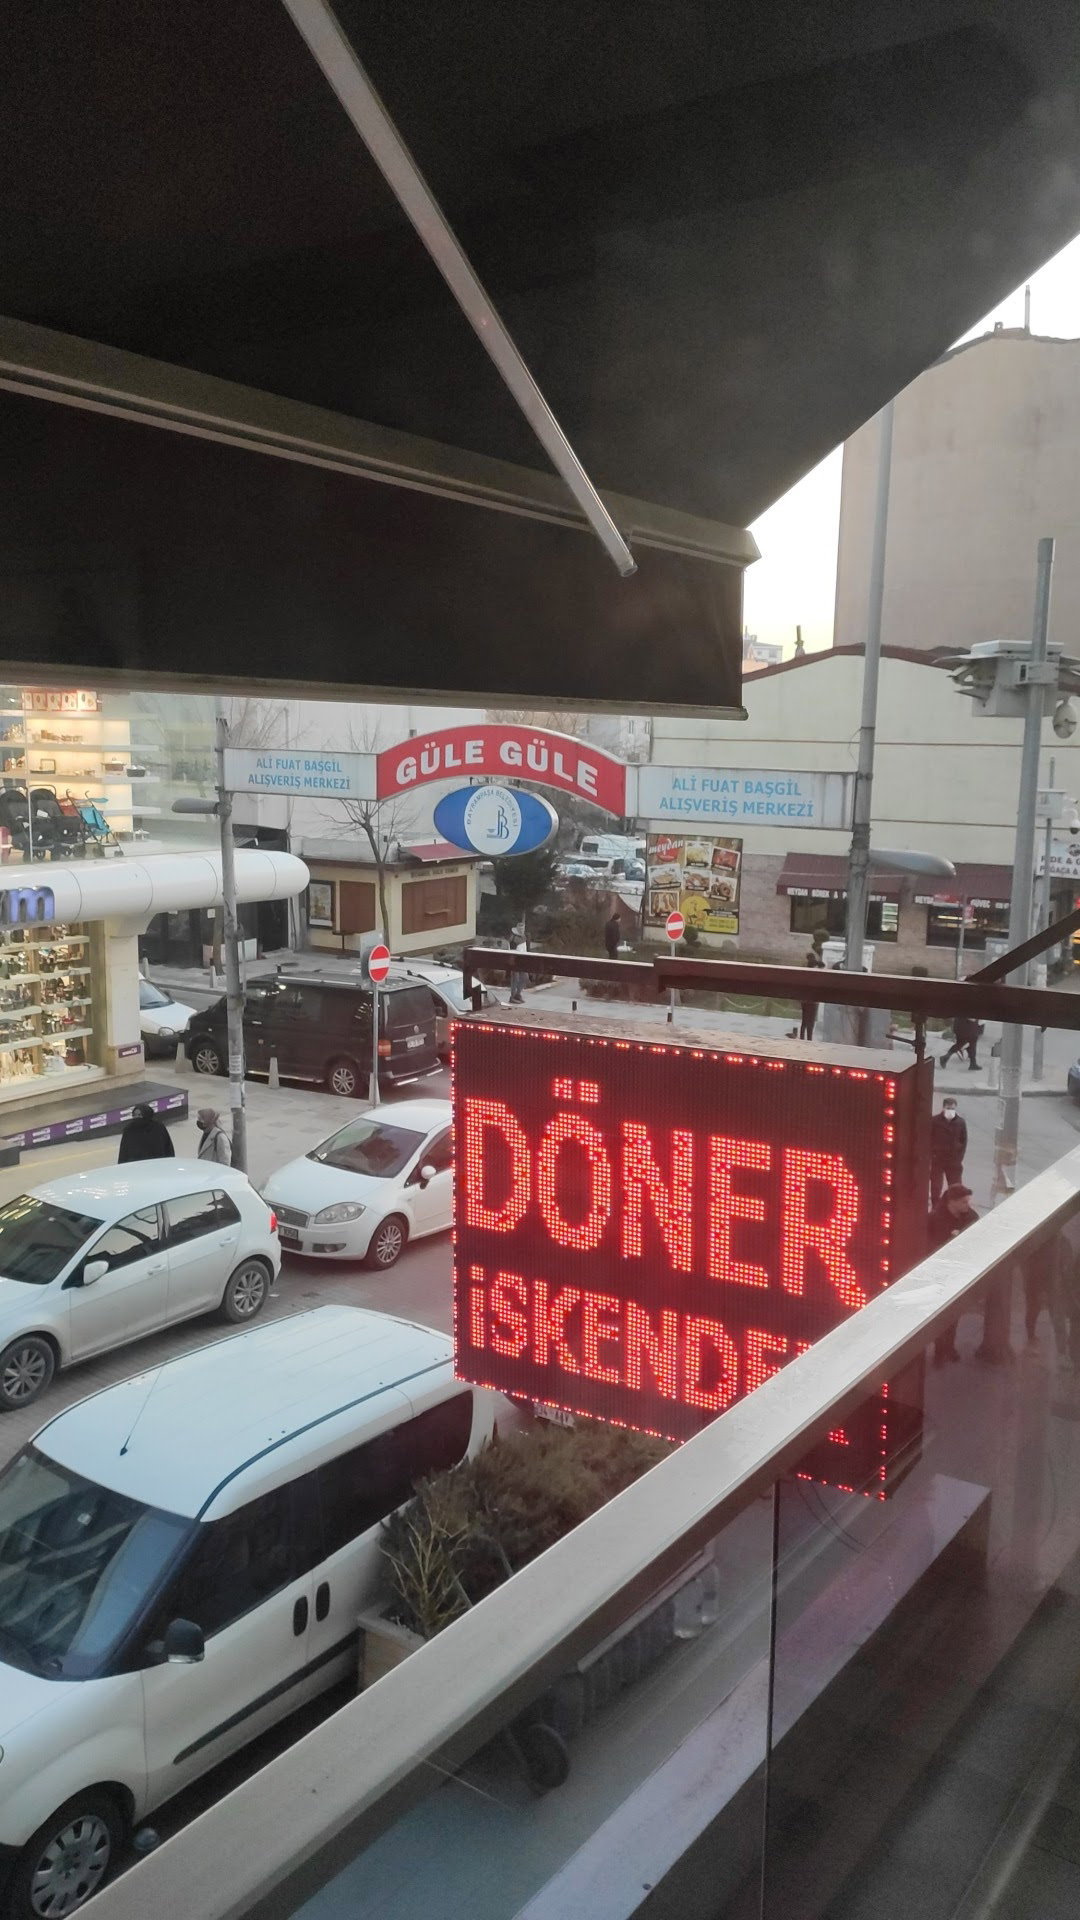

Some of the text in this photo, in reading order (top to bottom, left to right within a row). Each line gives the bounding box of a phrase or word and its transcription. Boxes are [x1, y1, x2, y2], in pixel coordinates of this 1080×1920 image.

[256, 755, 343, 774] ALİ FUAT BAŞGİL
[396, 738, 598, 797] GÜLE GÜLE
[247, 773, 351, 790] ALIŞVERİŞ MERKEZİ
[672, 775, 802, 798] ALİ FUAT BAŞGİL
[659, 796, 814, 817] ALIŞVERİŞ MERKEZİ
[466, 1078, 867, 1309] DÖNER
